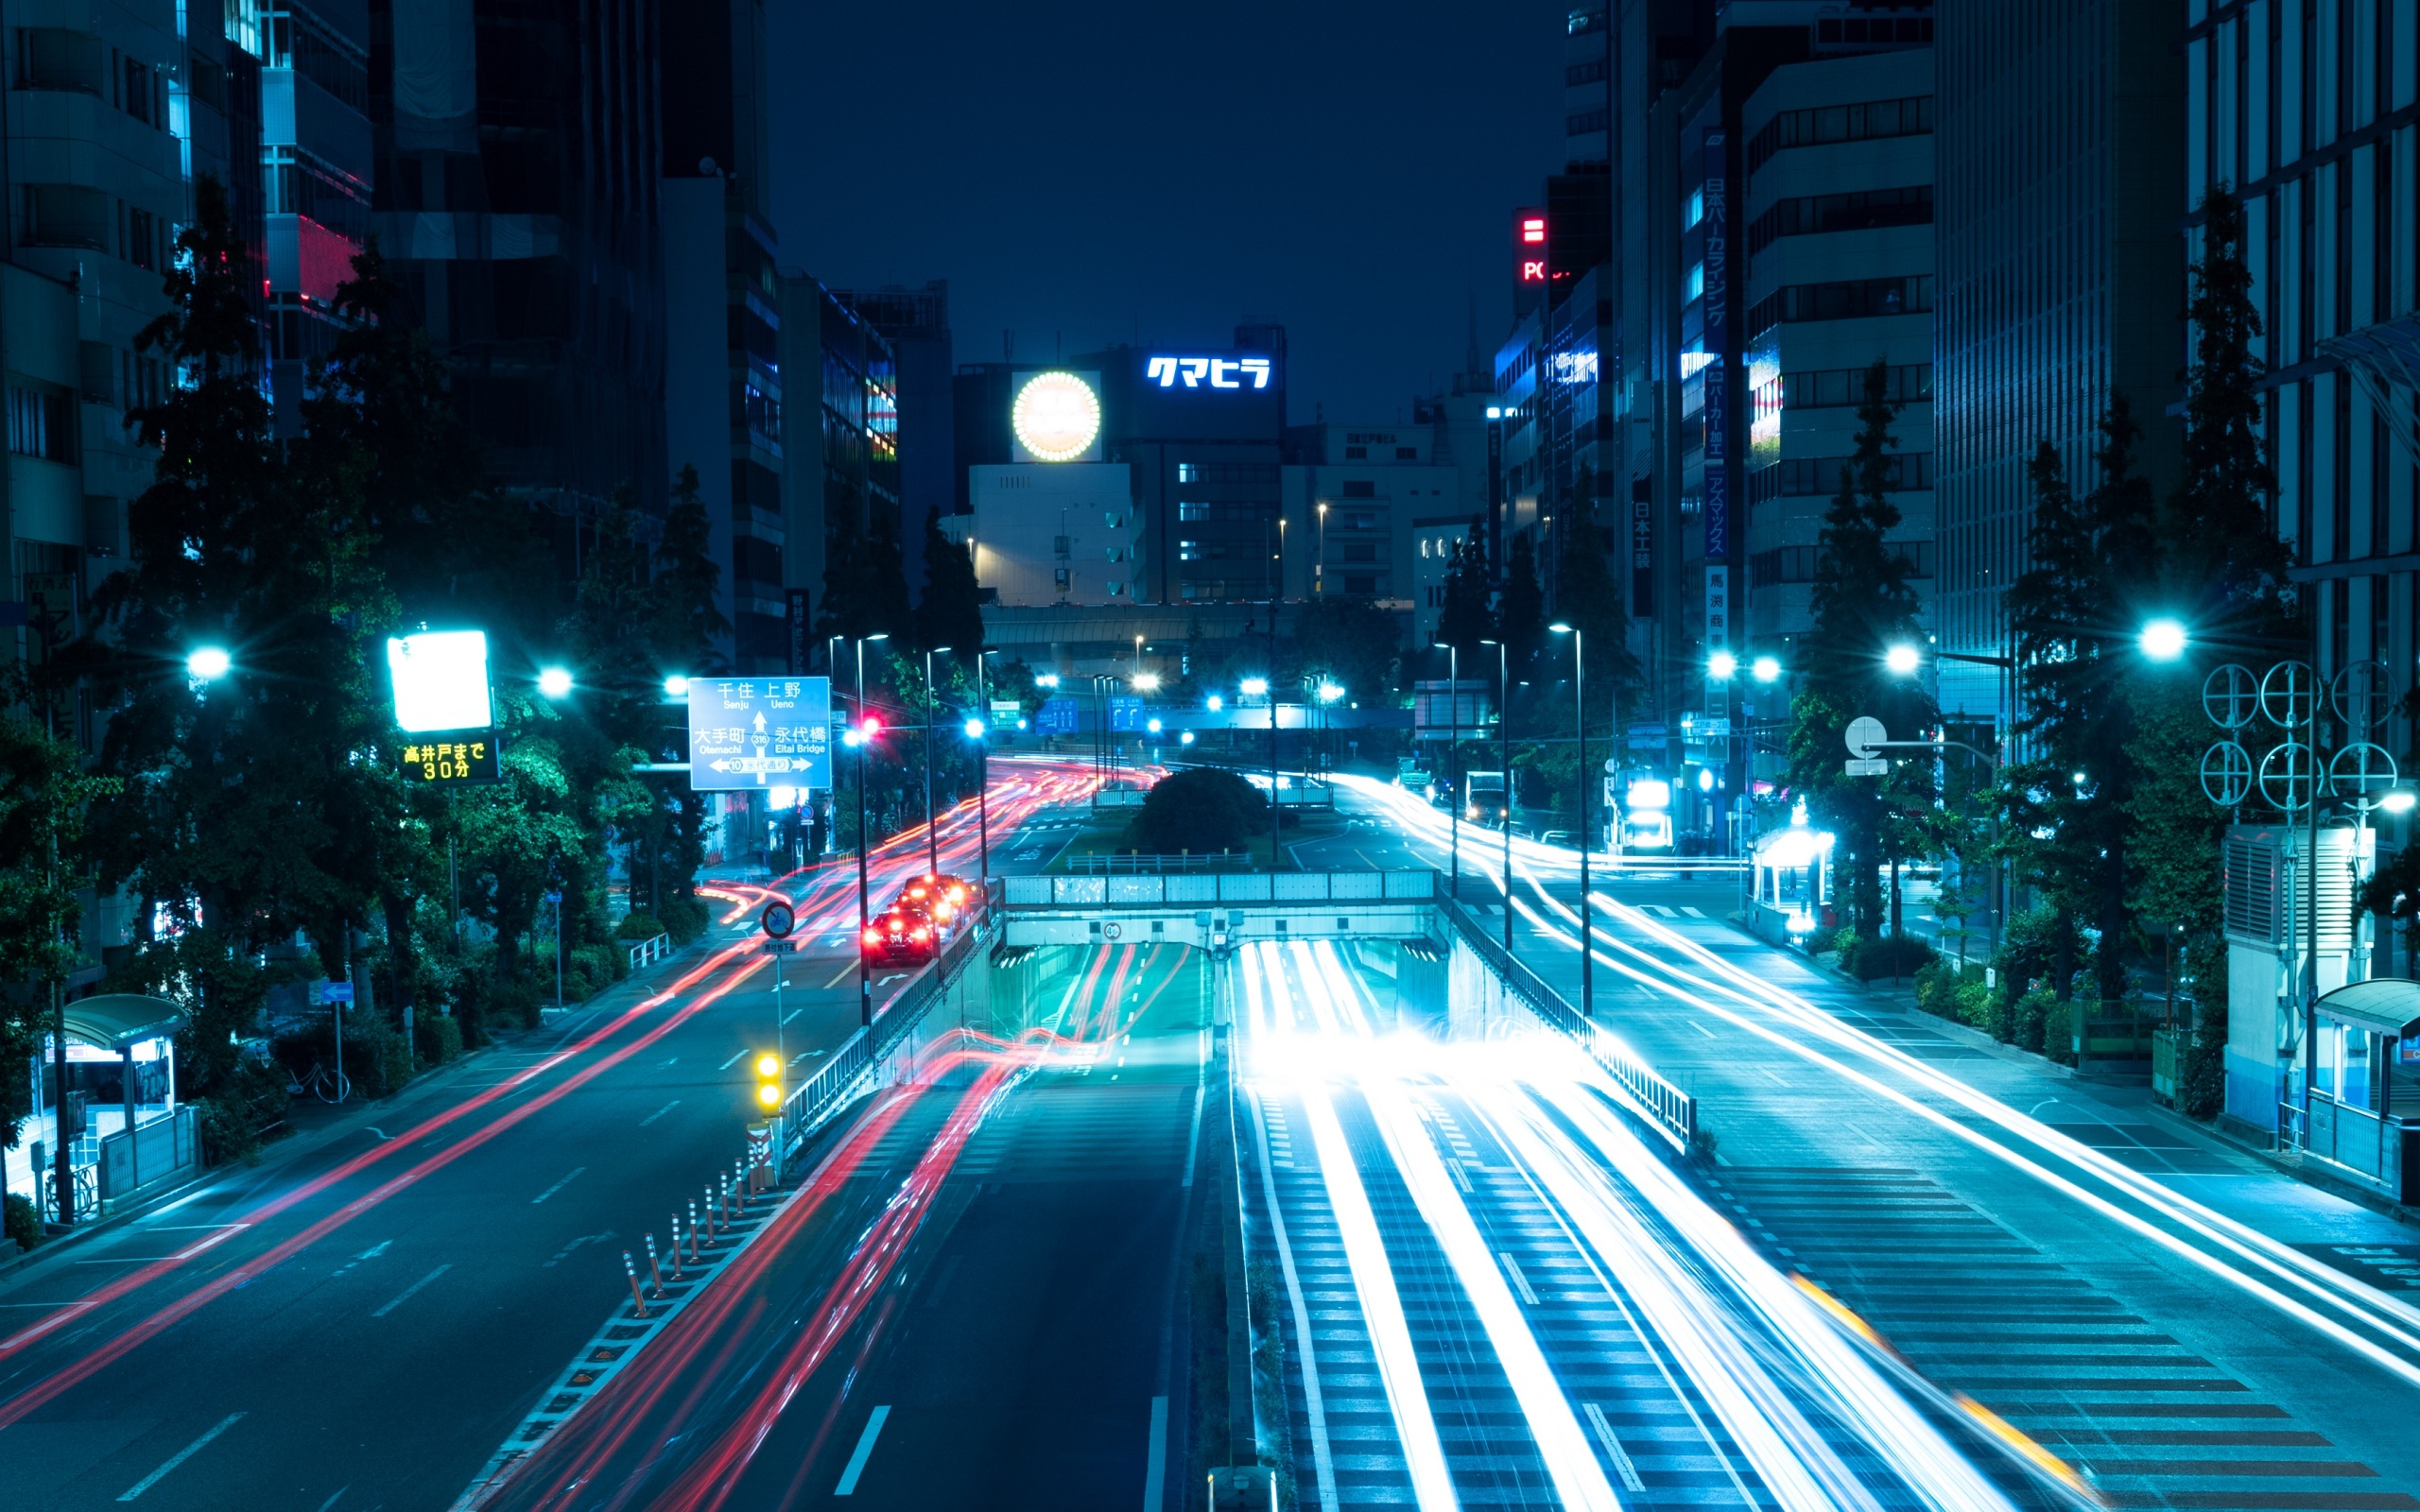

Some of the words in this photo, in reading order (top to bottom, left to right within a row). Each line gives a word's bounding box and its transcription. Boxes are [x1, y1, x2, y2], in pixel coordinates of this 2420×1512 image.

[1706, 179, 1725, 326] 日本パーカライジング
[1147, 357, 1270, 388] クマヒラ
[1710, 386, 1723, 455] パーカー加工
[1709, 477, 1724, 554] アズマックス
[1634, 503, 1651, 568] 日本工装
[717, 682, 754, 699] 千住
[764, 682, 801, 699] 上野
[723, 700, 749, 711] Senju
[771, 700, 794, 709] Ueno
[694, 727, 746, 745] 大手町
[753, 734, 768, 744] 316
[774, 726, 826, 744] 永代橋
[404, 742, 485, 764] 高井戸まで
[700, 745, 742, 755] Otemachi
[775, 745, 795, 754] Eitai
[797, 744, 825, 755] Bridge
[424, 761, 470, 780] 30分
[731, 760, 741, 770] 10
[745, 759, 786, 770] 永代通り
